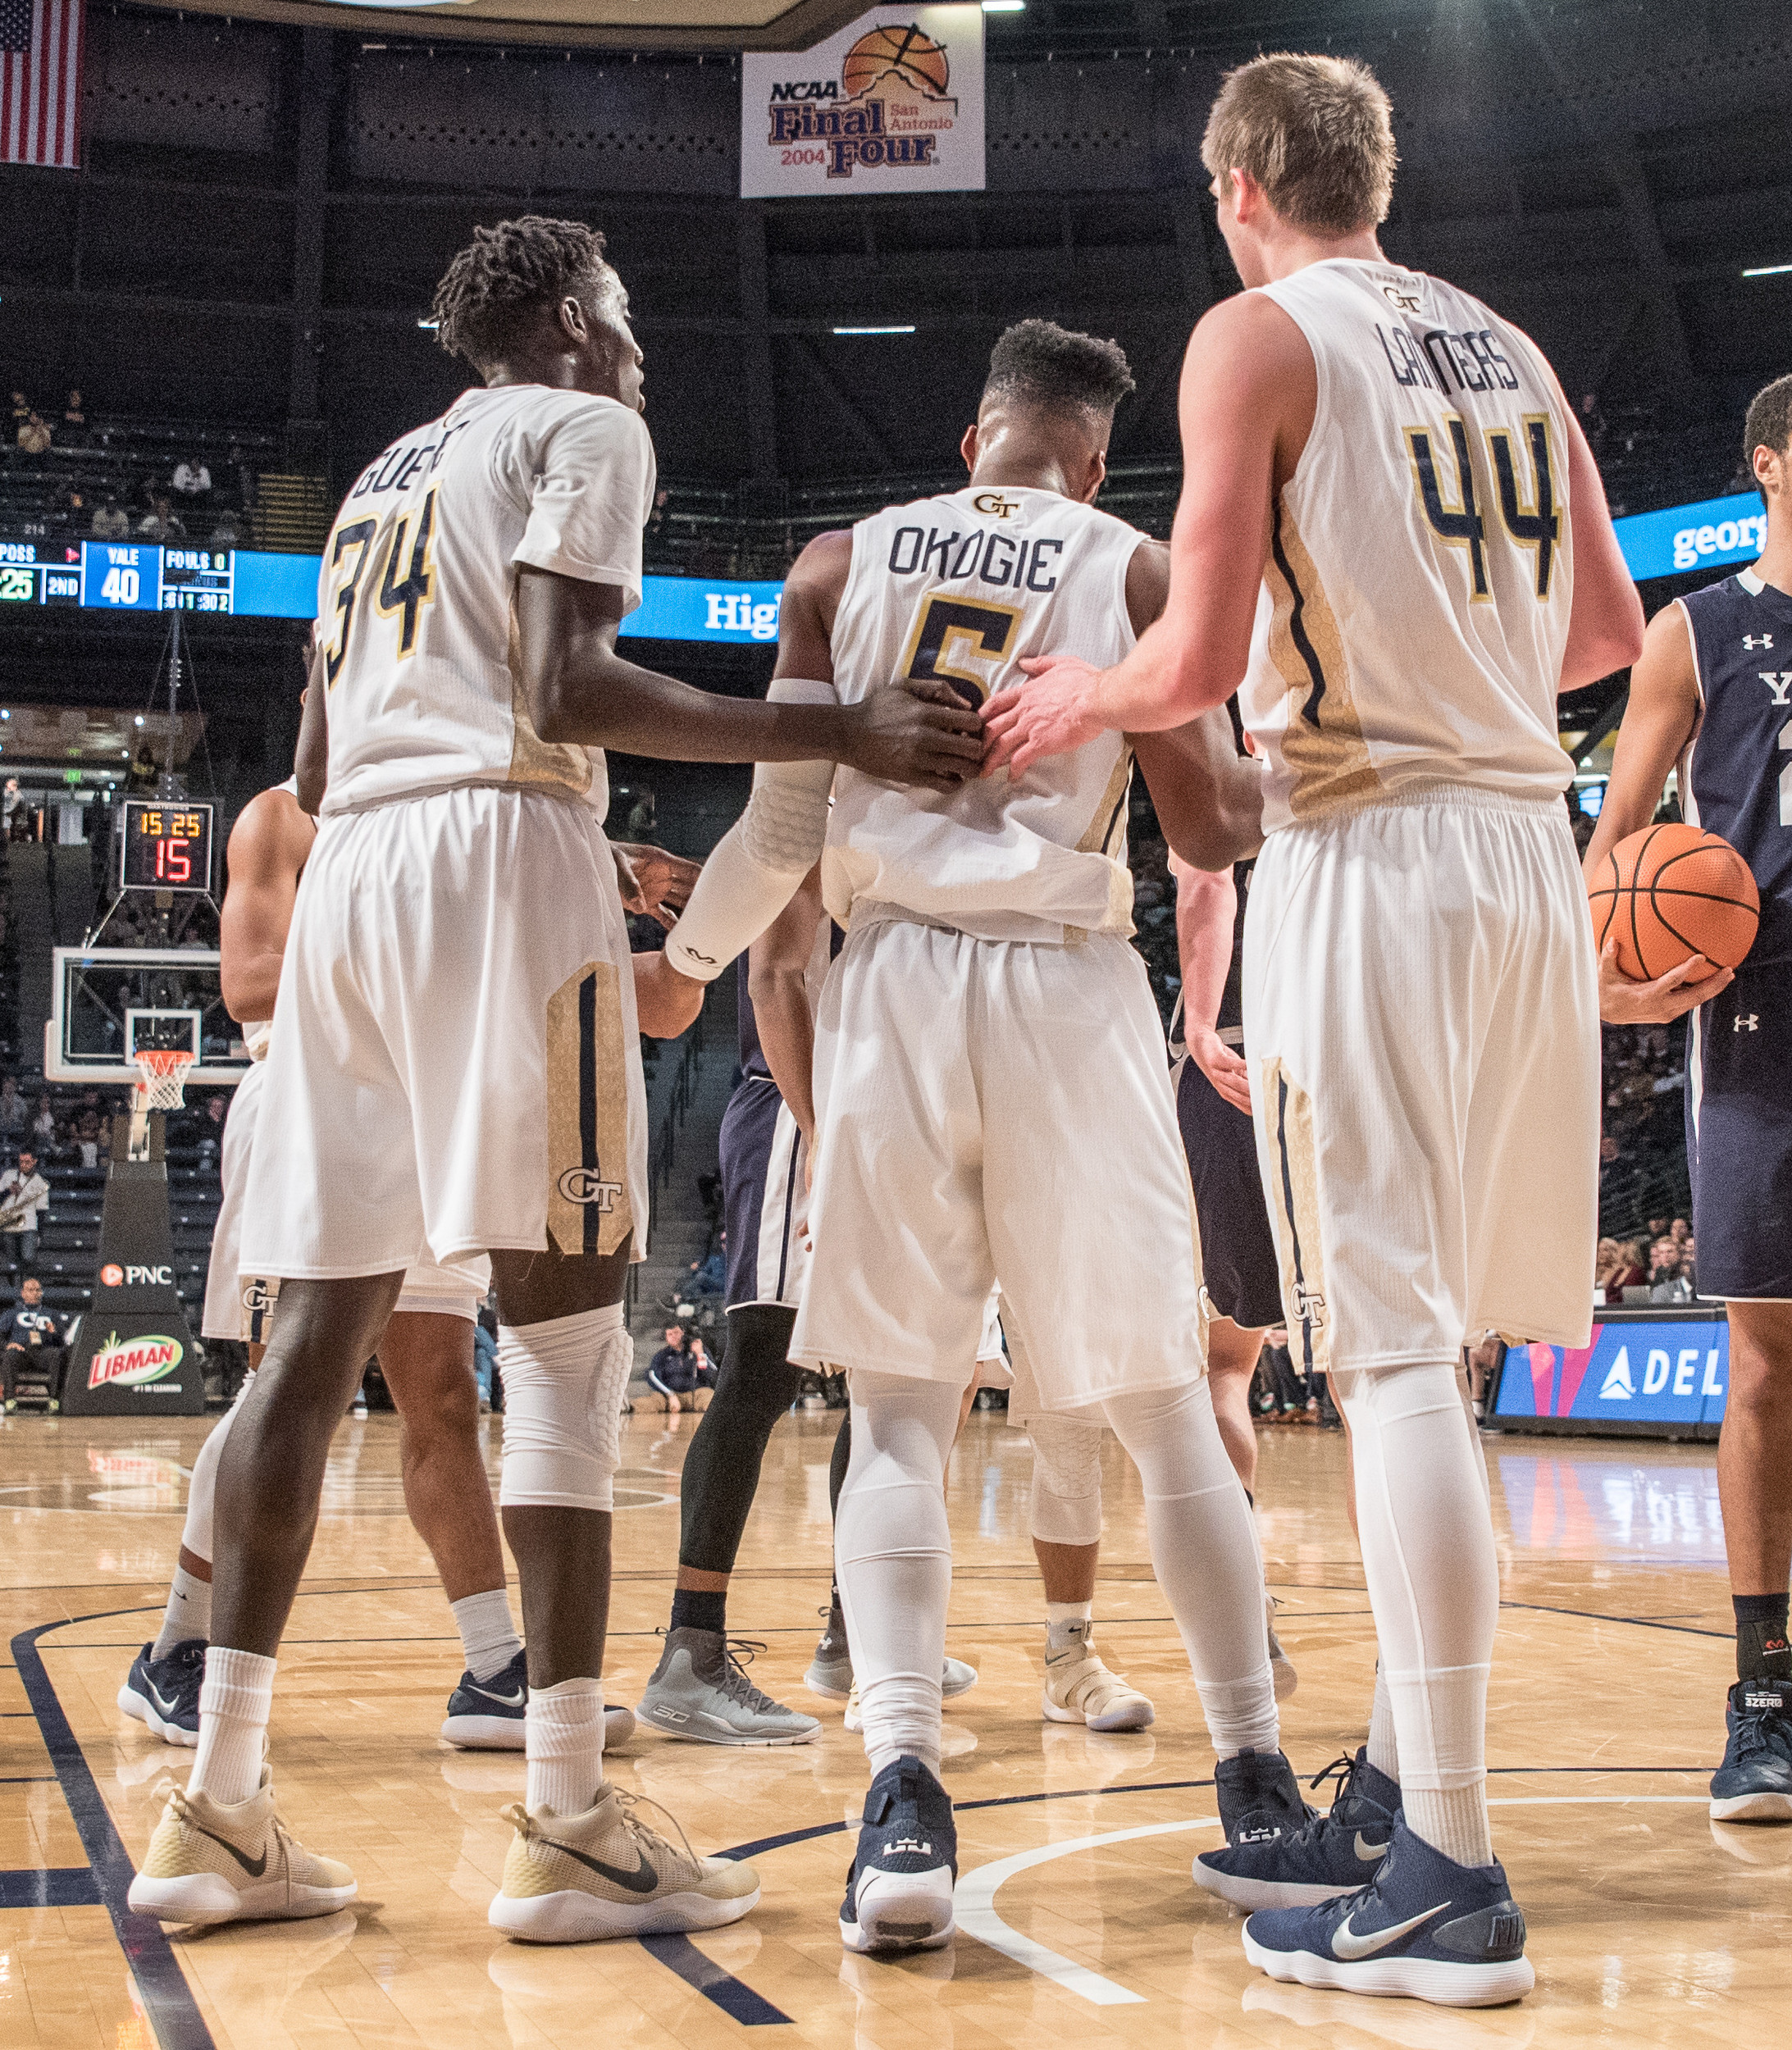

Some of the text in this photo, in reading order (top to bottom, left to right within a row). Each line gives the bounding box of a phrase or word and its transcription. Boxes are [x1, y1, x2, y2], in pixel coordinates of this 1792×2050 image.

[770, 81, 838, 102] NCAA
[769, 100, 885, 145] Final
[891, 104, 919, 116] San
[891, 117, 953, 130] Antonio
[782, 149, 825, 166] 2004
[828, 135, 935, 178] Four
[973, 494, 1019, 518] GT
[1402, 412, 1562, 604] 44
[0, 543, 36, 563] POSS
[107, 547, 139, 566] YALE
[166, 550, 211, 570] FOULS
[888, 526, 1064, 593] OKOGIE
[47, 576, 79, 596] 2ND
[101, 567, 140, 605] 40
[325, 477, 444, 693] 34
[141, 811, 201, 837] 15 25
[156, 837, 191, 882] 15
[558, 1166, 622, 1213] GT
[125, 1265, 172, 1285] PNC
[91, 1344, 175, 1386] LIBMAN
[1641, 1348, 1723, 1396] DEL
